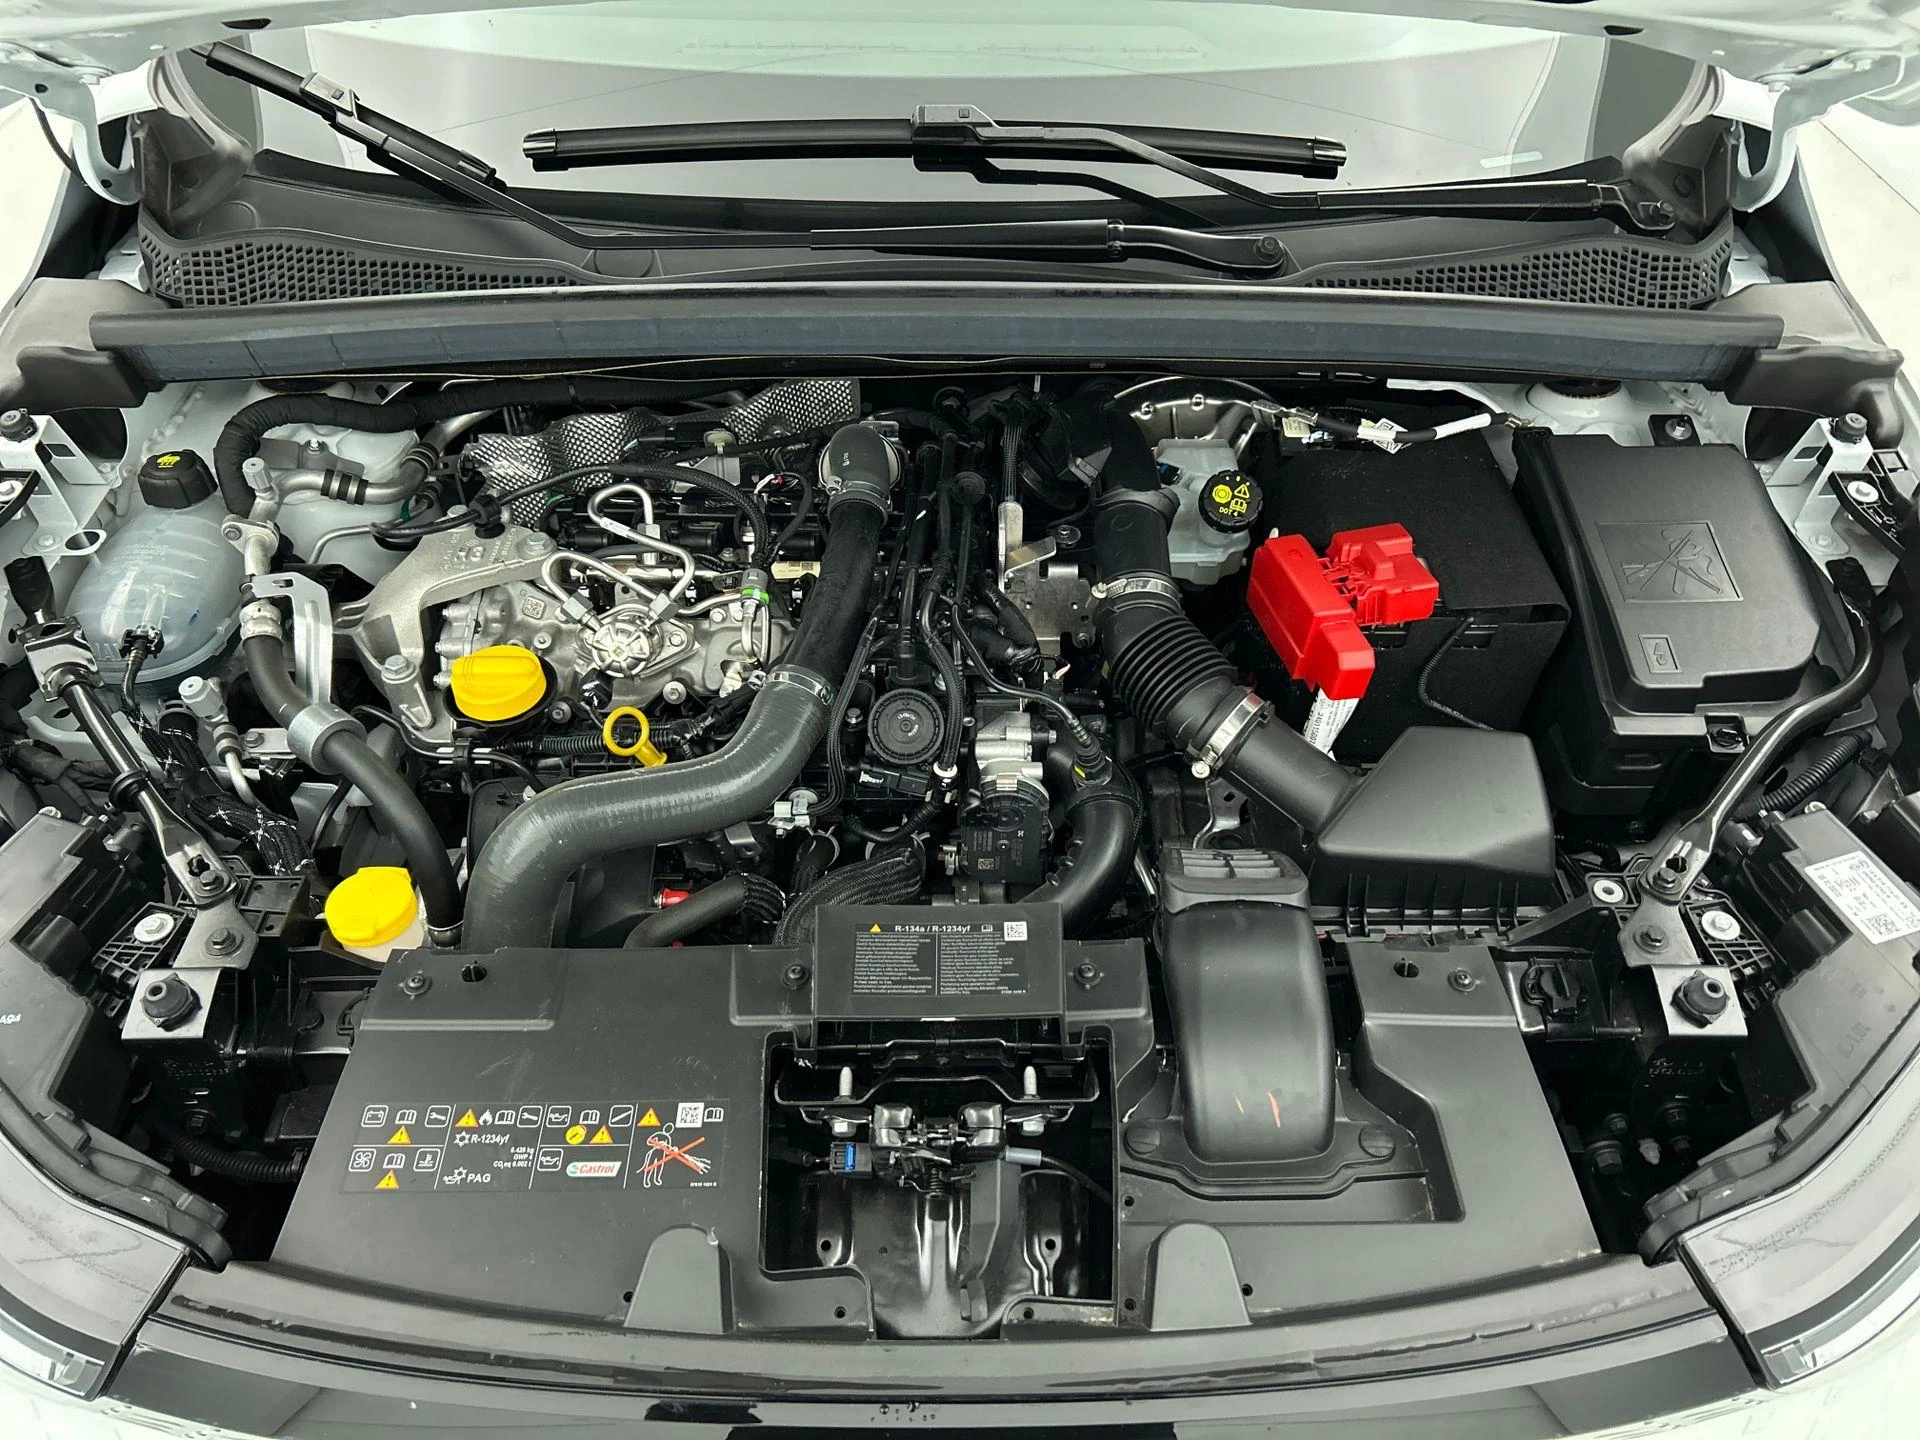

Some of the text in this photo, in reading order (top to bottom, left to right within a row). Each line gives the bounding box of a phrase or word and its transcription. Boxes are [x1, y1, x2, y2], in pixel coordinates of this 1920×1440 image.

[1219, 507, 1233, 515] DOT
[932, 925, 970, 934] R-1234yf
[470, 1134, 510, 1145] R-1234yf
[579, 1164, 615, 1174] Castrol
[467, 1173, 491, 1182] PAG
